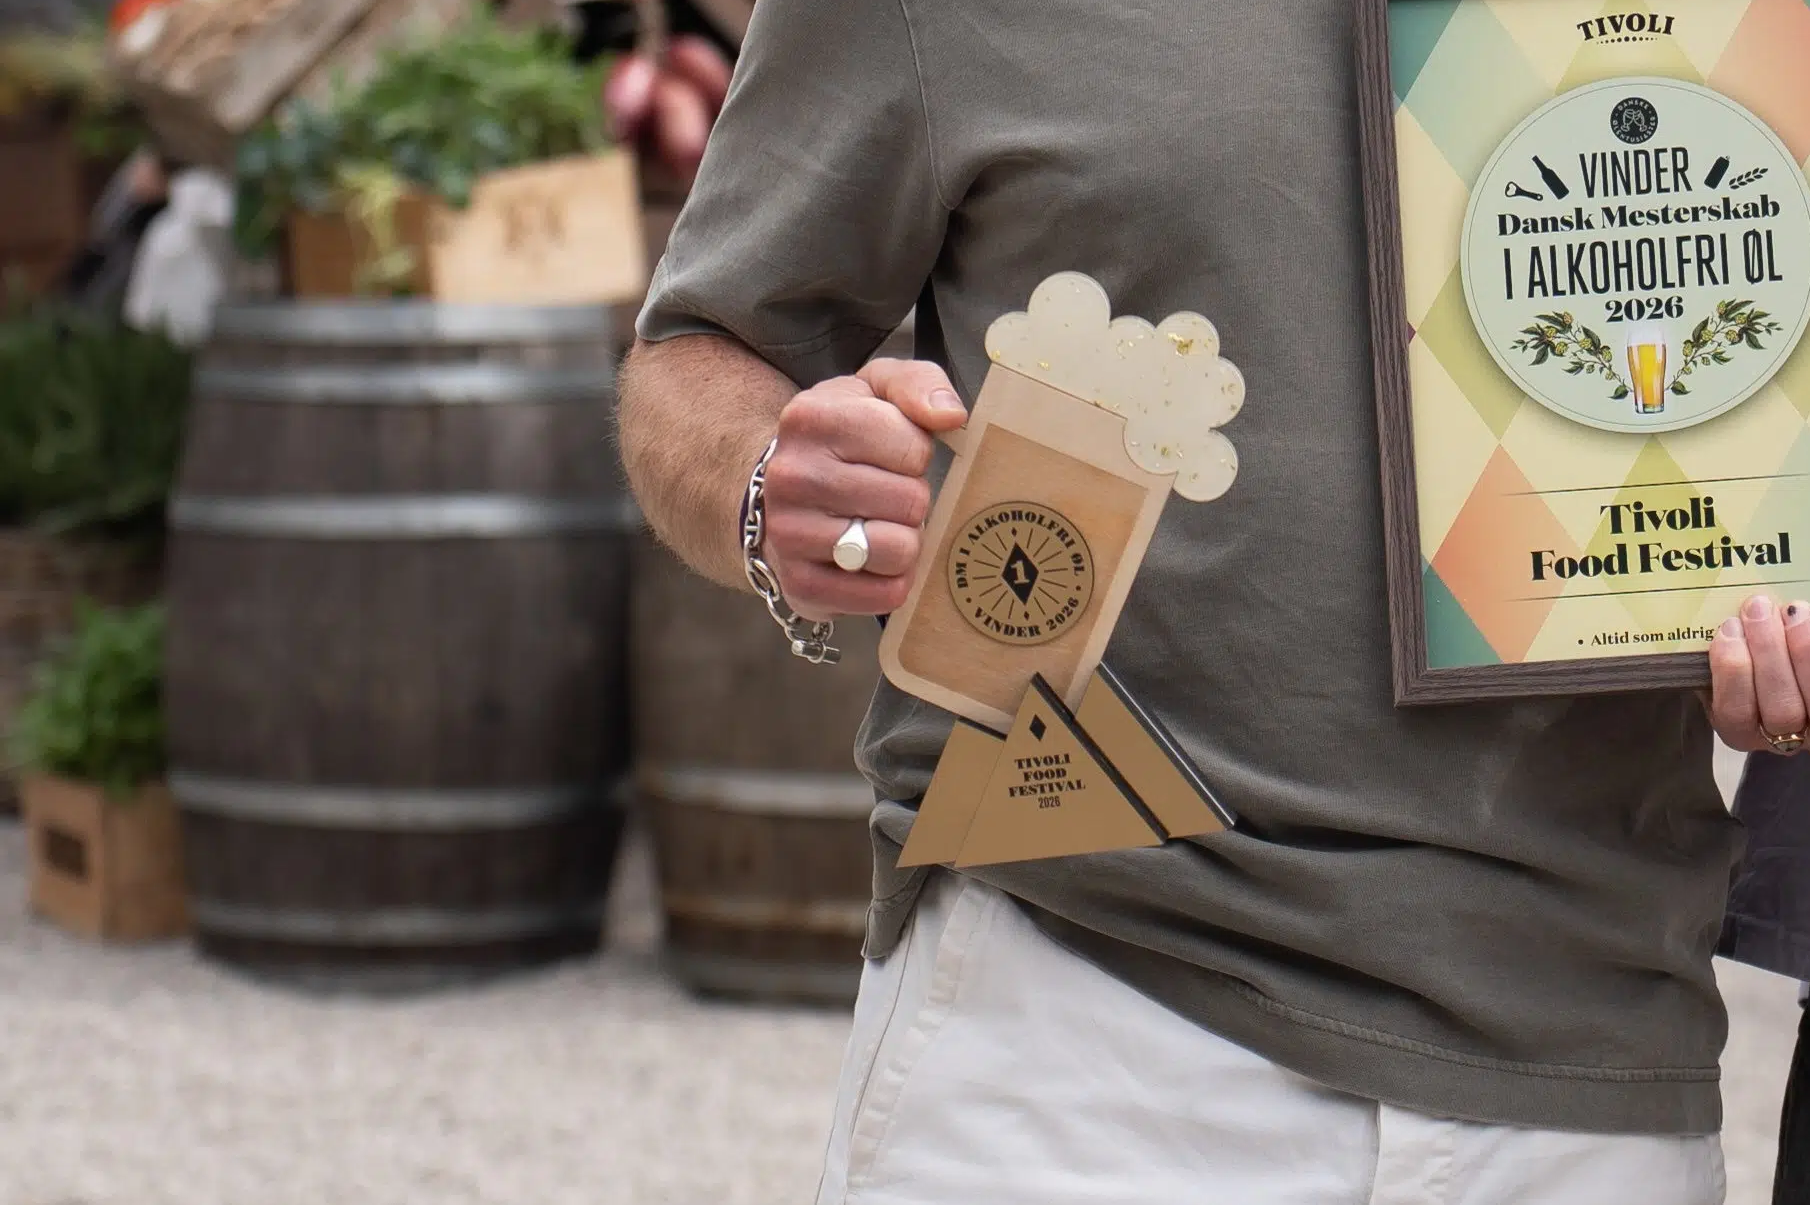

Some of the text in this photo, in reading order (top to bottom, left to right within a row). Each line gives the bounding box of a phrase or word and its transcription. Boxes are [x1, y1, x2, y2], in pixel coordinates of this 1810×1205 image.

[1577, 13, 1675, 41] TIVOLI
[1579, 146, 1693, 199] VINDER
[1496, 194, 1781, 237] Dansk Mesterskab
[1503, 228, 1783, 301] I ALKOHOLFRI ØL
[1604, 296, 1684, 324] 2026
[1600, 495, 1717, 535] Tivoli
[956, 562, 968, 589] DM
[968, 510, 1076, 549] ALKOHOLFRI
[1070, 552, 1085, 577] ØL
[1530, 532, 1793, 581] Food Festival
[1010, 560, 1031, 585] 1
[974, 597, 1079, 638] VINDER 2026
[1590, 626, 1715, 646] Altid som aldrig
[1014, 753, 1071, 770] TIVOLI
[1023, 767, 1067, 783] FOOD
[1007, 779, 1086, 798] FESTIVAL
